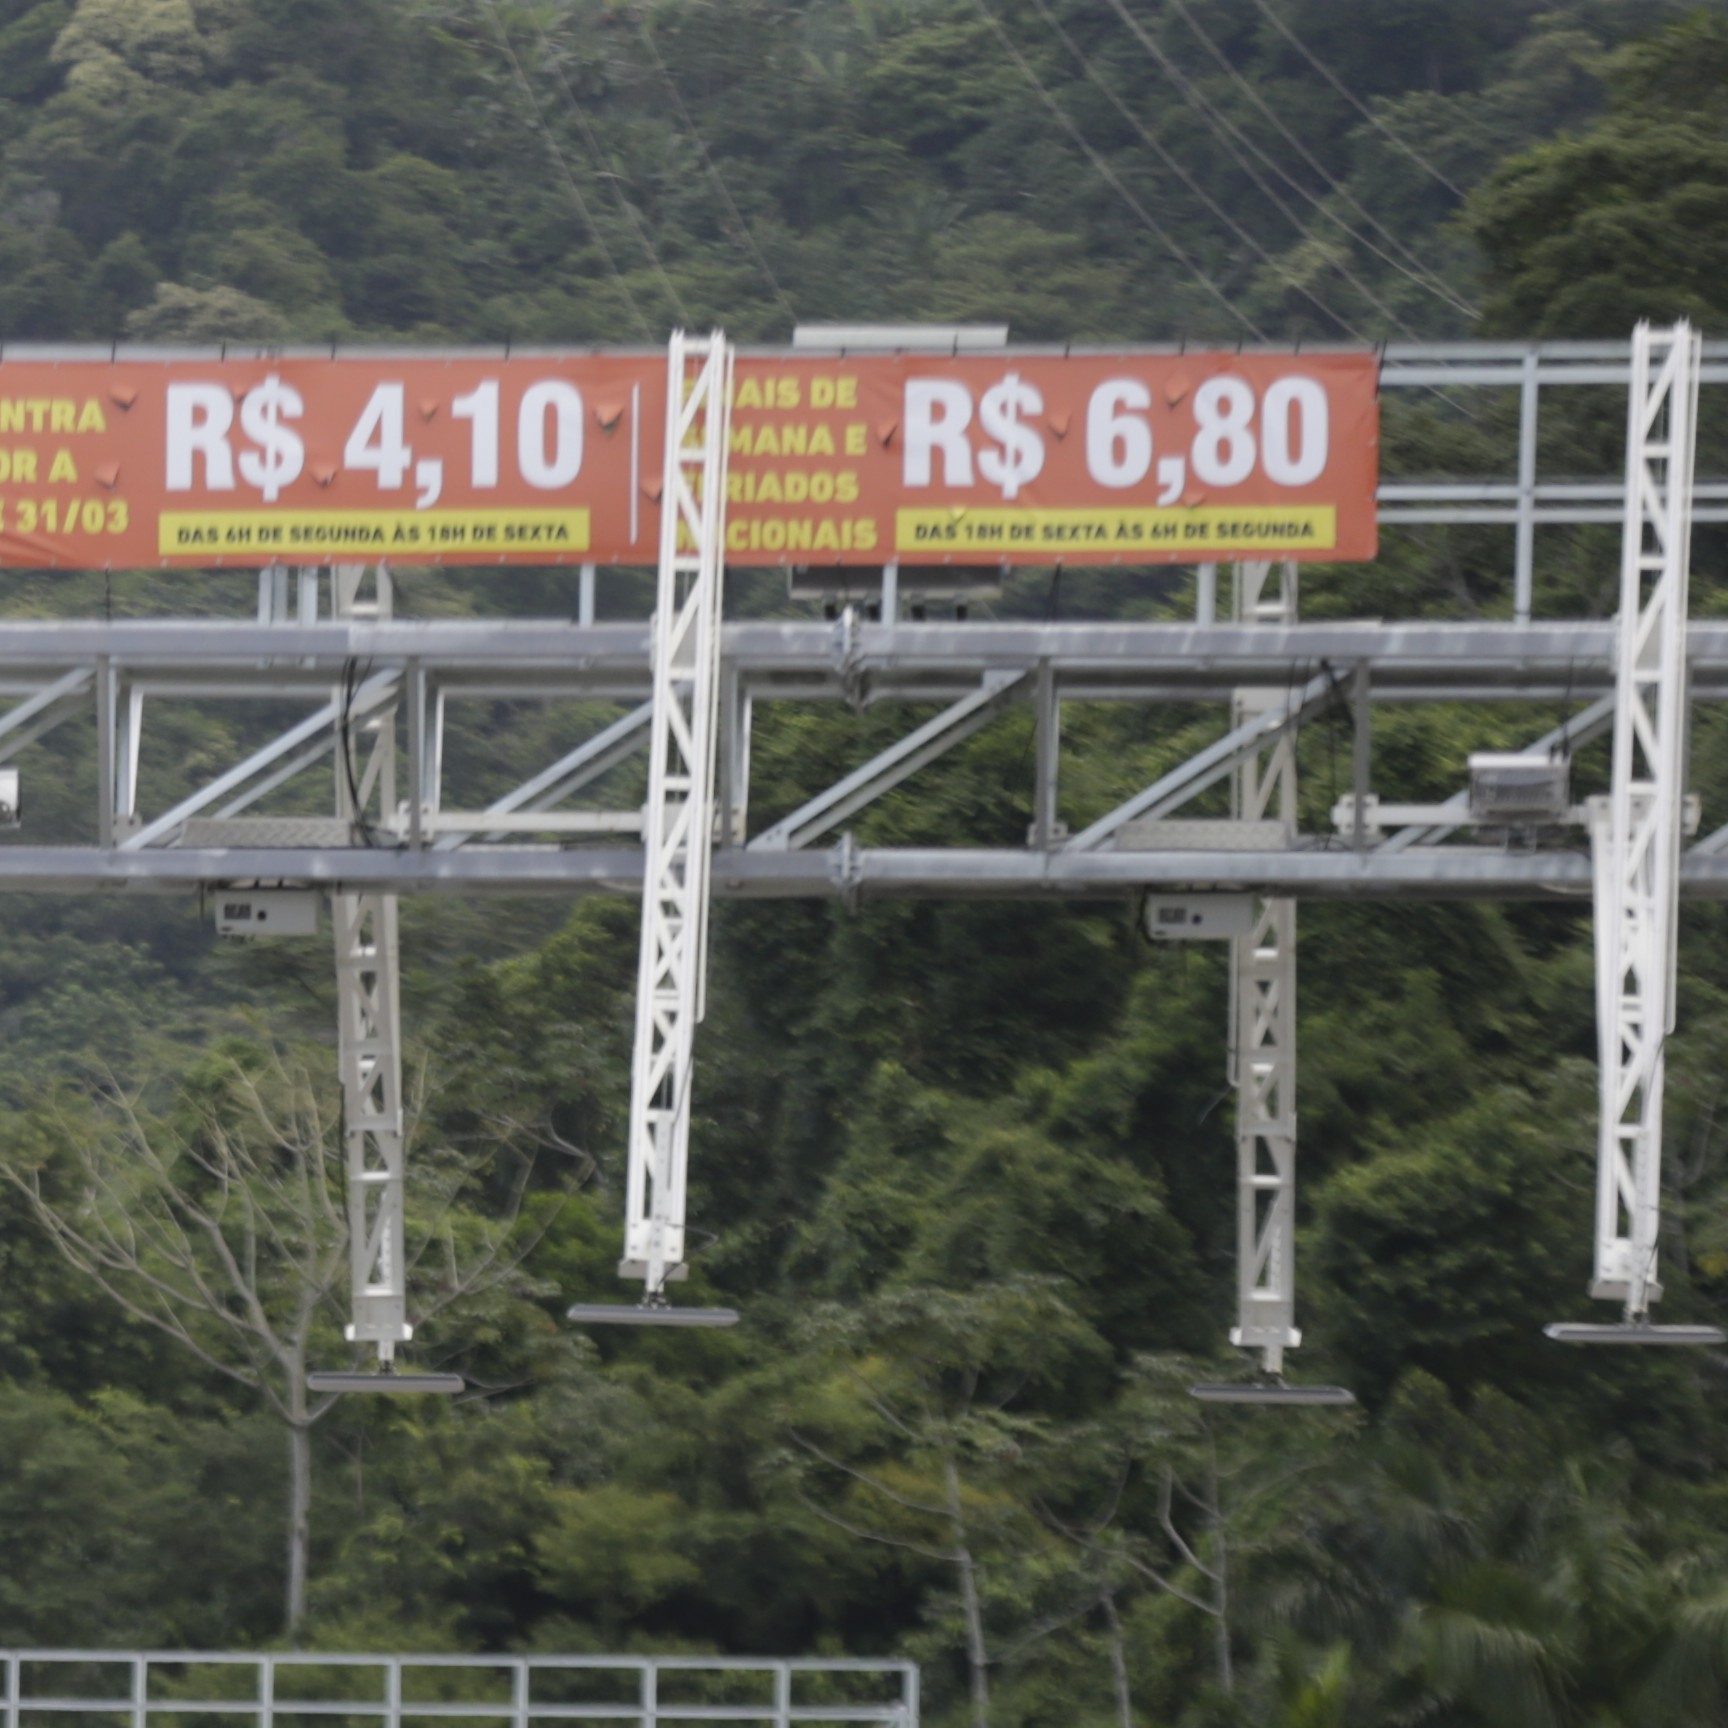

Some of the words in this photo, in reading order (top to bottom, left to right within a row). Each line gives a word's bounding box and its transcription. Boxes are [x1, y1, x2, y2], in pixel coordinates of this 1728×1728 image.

[810, 377, 858, 409] DE
[165, 373, 305, 502] R$
[344, 376, 584, 510] 4,10
[845, 423, 868, 456] E
[903, 373, 1045, 500] R$
[1086, 375, 1330, 506] 6,80
[48, 447, 78, 483] A
[16, 498, 129, 535] 31/03
[915, 523, 956, 541] DAS
[966, 523, 1002, 541] 18H
[1010, 522, 1035, 541] DE
[1043, 522, 1108, 541] SEXTA
[1151, 522, 1177, 540] 6H
[1185, 521, 1210, 540] DE
[1217, 520, 1314, 540] SEGUNDA
[178, 526, 218, 545] DAS
[225, 525, 251, 544] 6H
[257, 525, 282, 544] DE
[289, 524, 384, 544] SEGUNDA
[428, 524, 465, 542] 18H
[473, 523, 497, 542] DE
[504, 523, 569, 542] SEXTA
